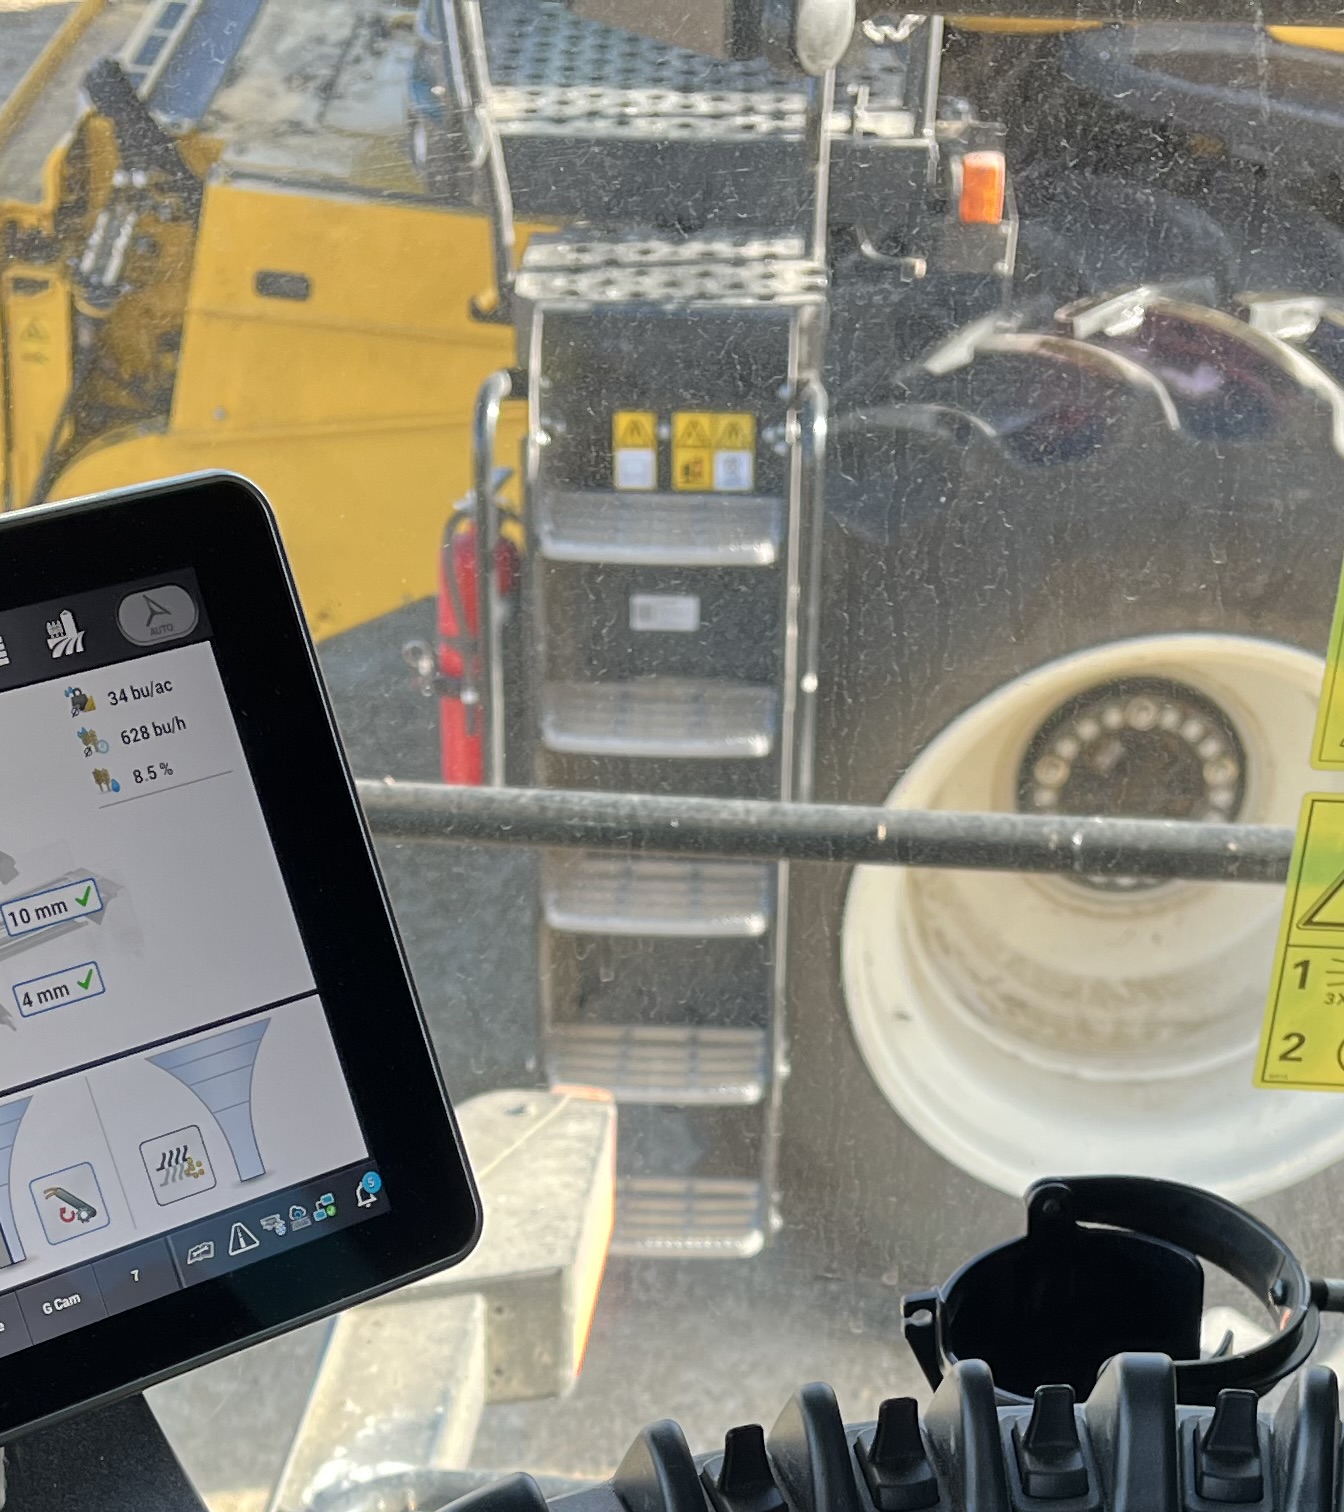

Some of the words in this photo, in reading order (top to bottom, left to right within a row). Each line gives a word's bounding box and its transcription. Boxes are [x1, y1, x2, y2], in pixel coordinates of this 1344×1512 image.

[150, 624, 173, 636] AUTO
[107, 688, 128, 705] 34
[130, 680, 173, 700] bu/ac
[120, 727, 150, 745] 628
[152, 715, 187, 736] bu/h
[133, 765, 157, 784] 8.5
[7, 908, 31, 928] 10
[35, 899, 69, 921] mm
[1293, 959, 1311, 990] 1
[22, 991, 34, 1009] 4
[36, 982, 71, 1005] mm
[1278, 1032, 1306, 1062] 2
[130, 1269, 140, 1282] 7
[42, 1302, 53, 1316] G
[54, 1292, 82, 1312] Cam
